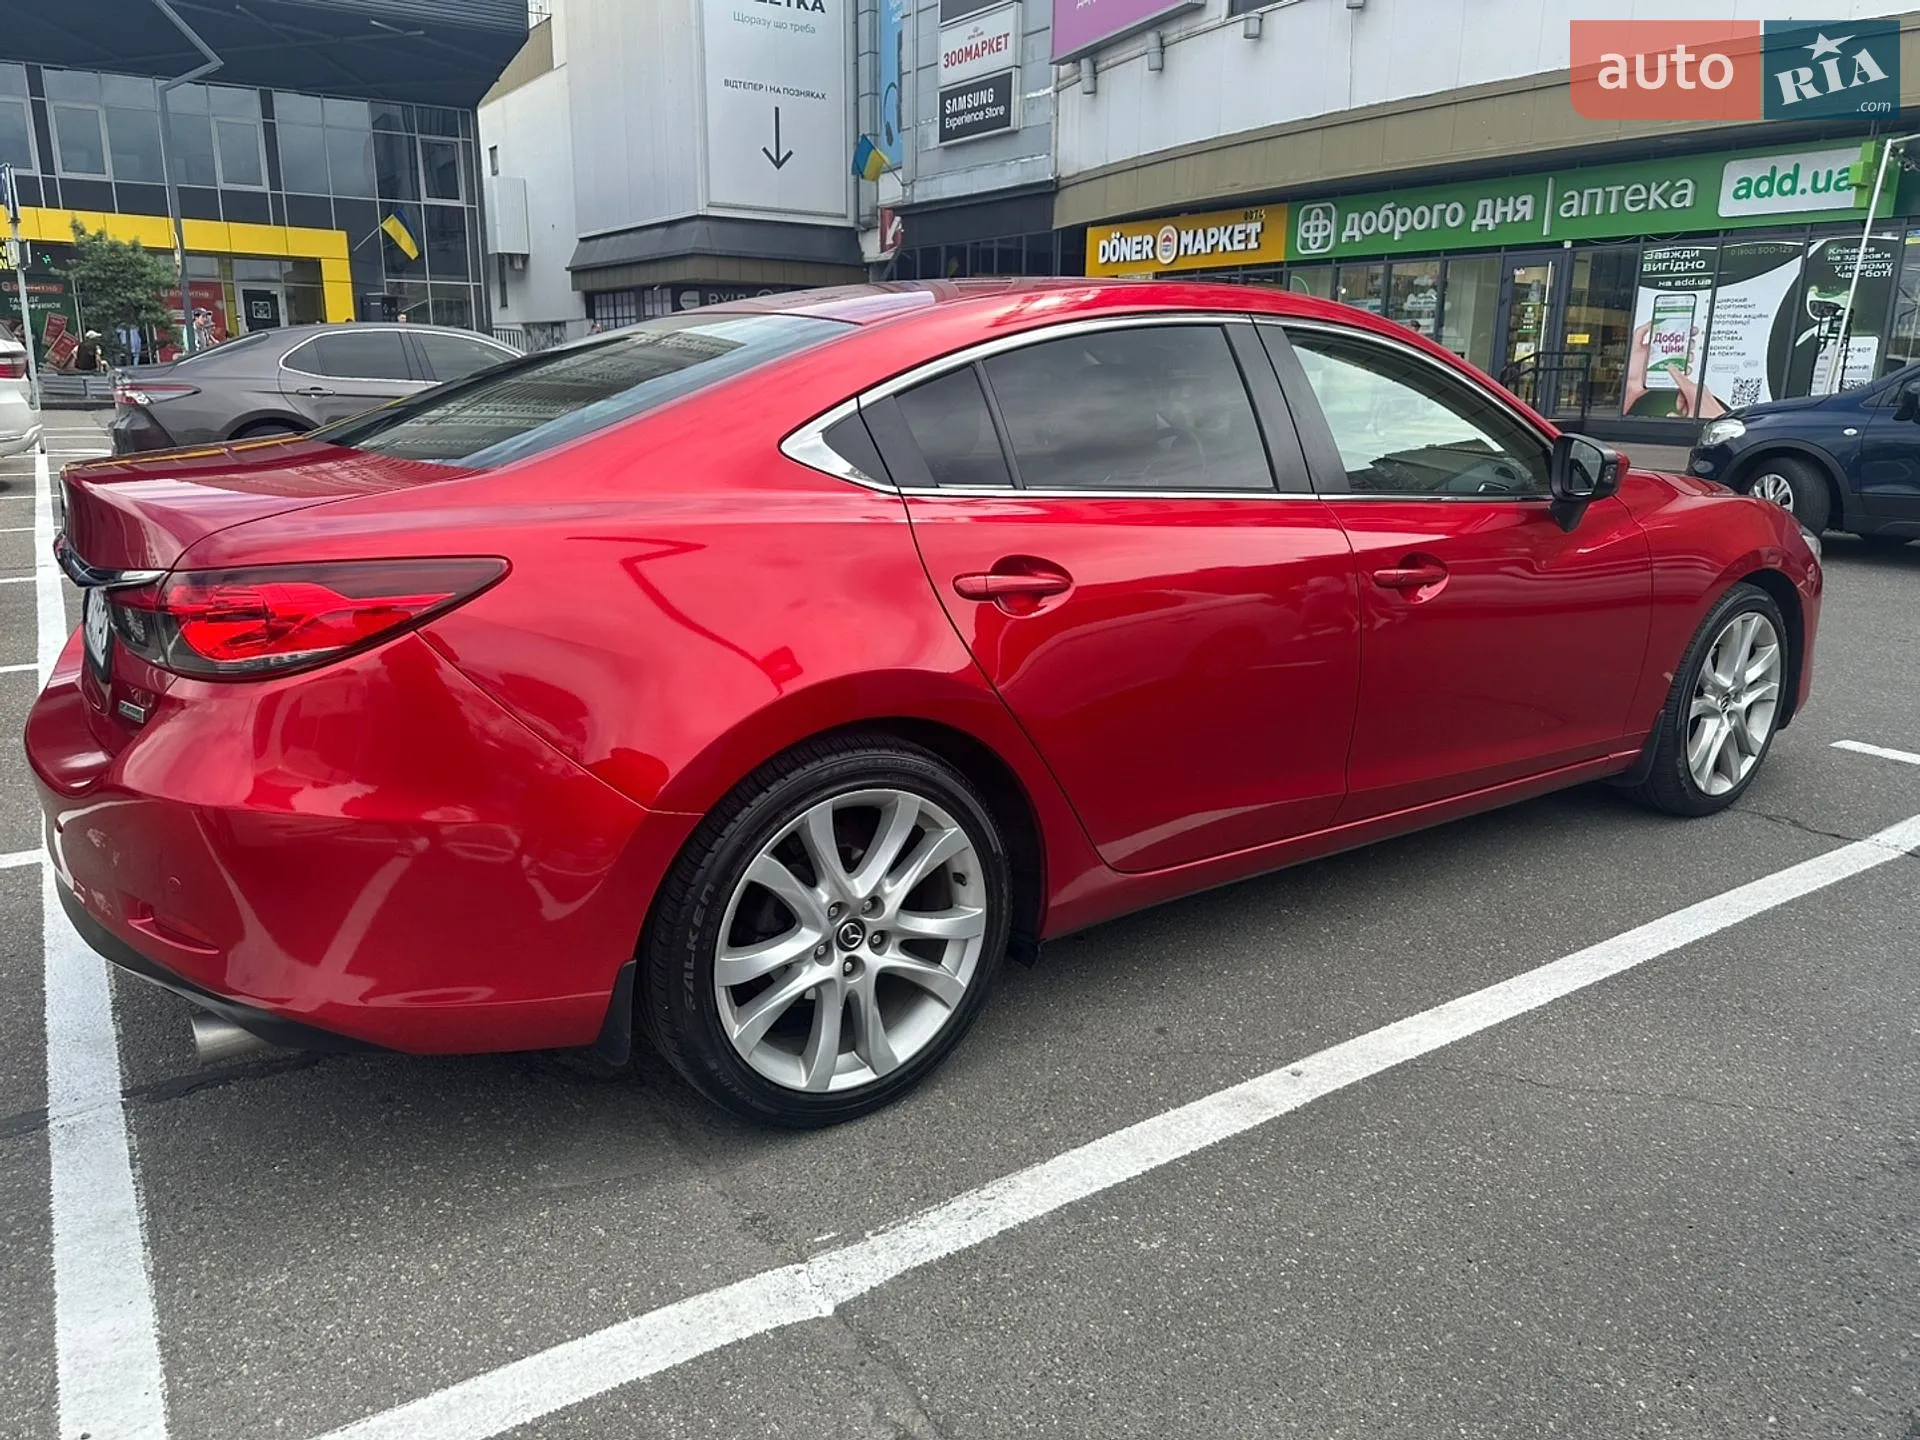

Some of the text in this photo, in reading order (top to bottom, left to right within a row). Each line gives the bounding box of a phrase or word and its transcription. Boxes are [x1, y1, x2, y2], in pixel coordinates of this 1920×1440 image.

[733, 11, 816, 34] Щоразу що треба
[943, 32, 1010, 69] ЗООМАРКЕТ
[723, 78, 764, 92] ВІДТЕПЕР
[769, 86, 781, 95] НА
[782, 87, 827, 101] ПОЗНЯКАХ
[945, 87, 994, 114] SAMSUNG
[945, 104, 1006, 130] Experience Store
[1732, 162, 1853, 200] add.ua
[1341, 177, 1697, 244] доброго дня аптека
[1098, 220, 1264, 265] DÖNER МАРКЕТ
[1642, 259, 1706, 272] вигідно
[1644, 249, 1699, 260] Завжди
[1657, 278, 1712, 287] на add.ua
[1653, 331, 1685, 345] Добрі
[1661, 344, 1684, 356] ціни
